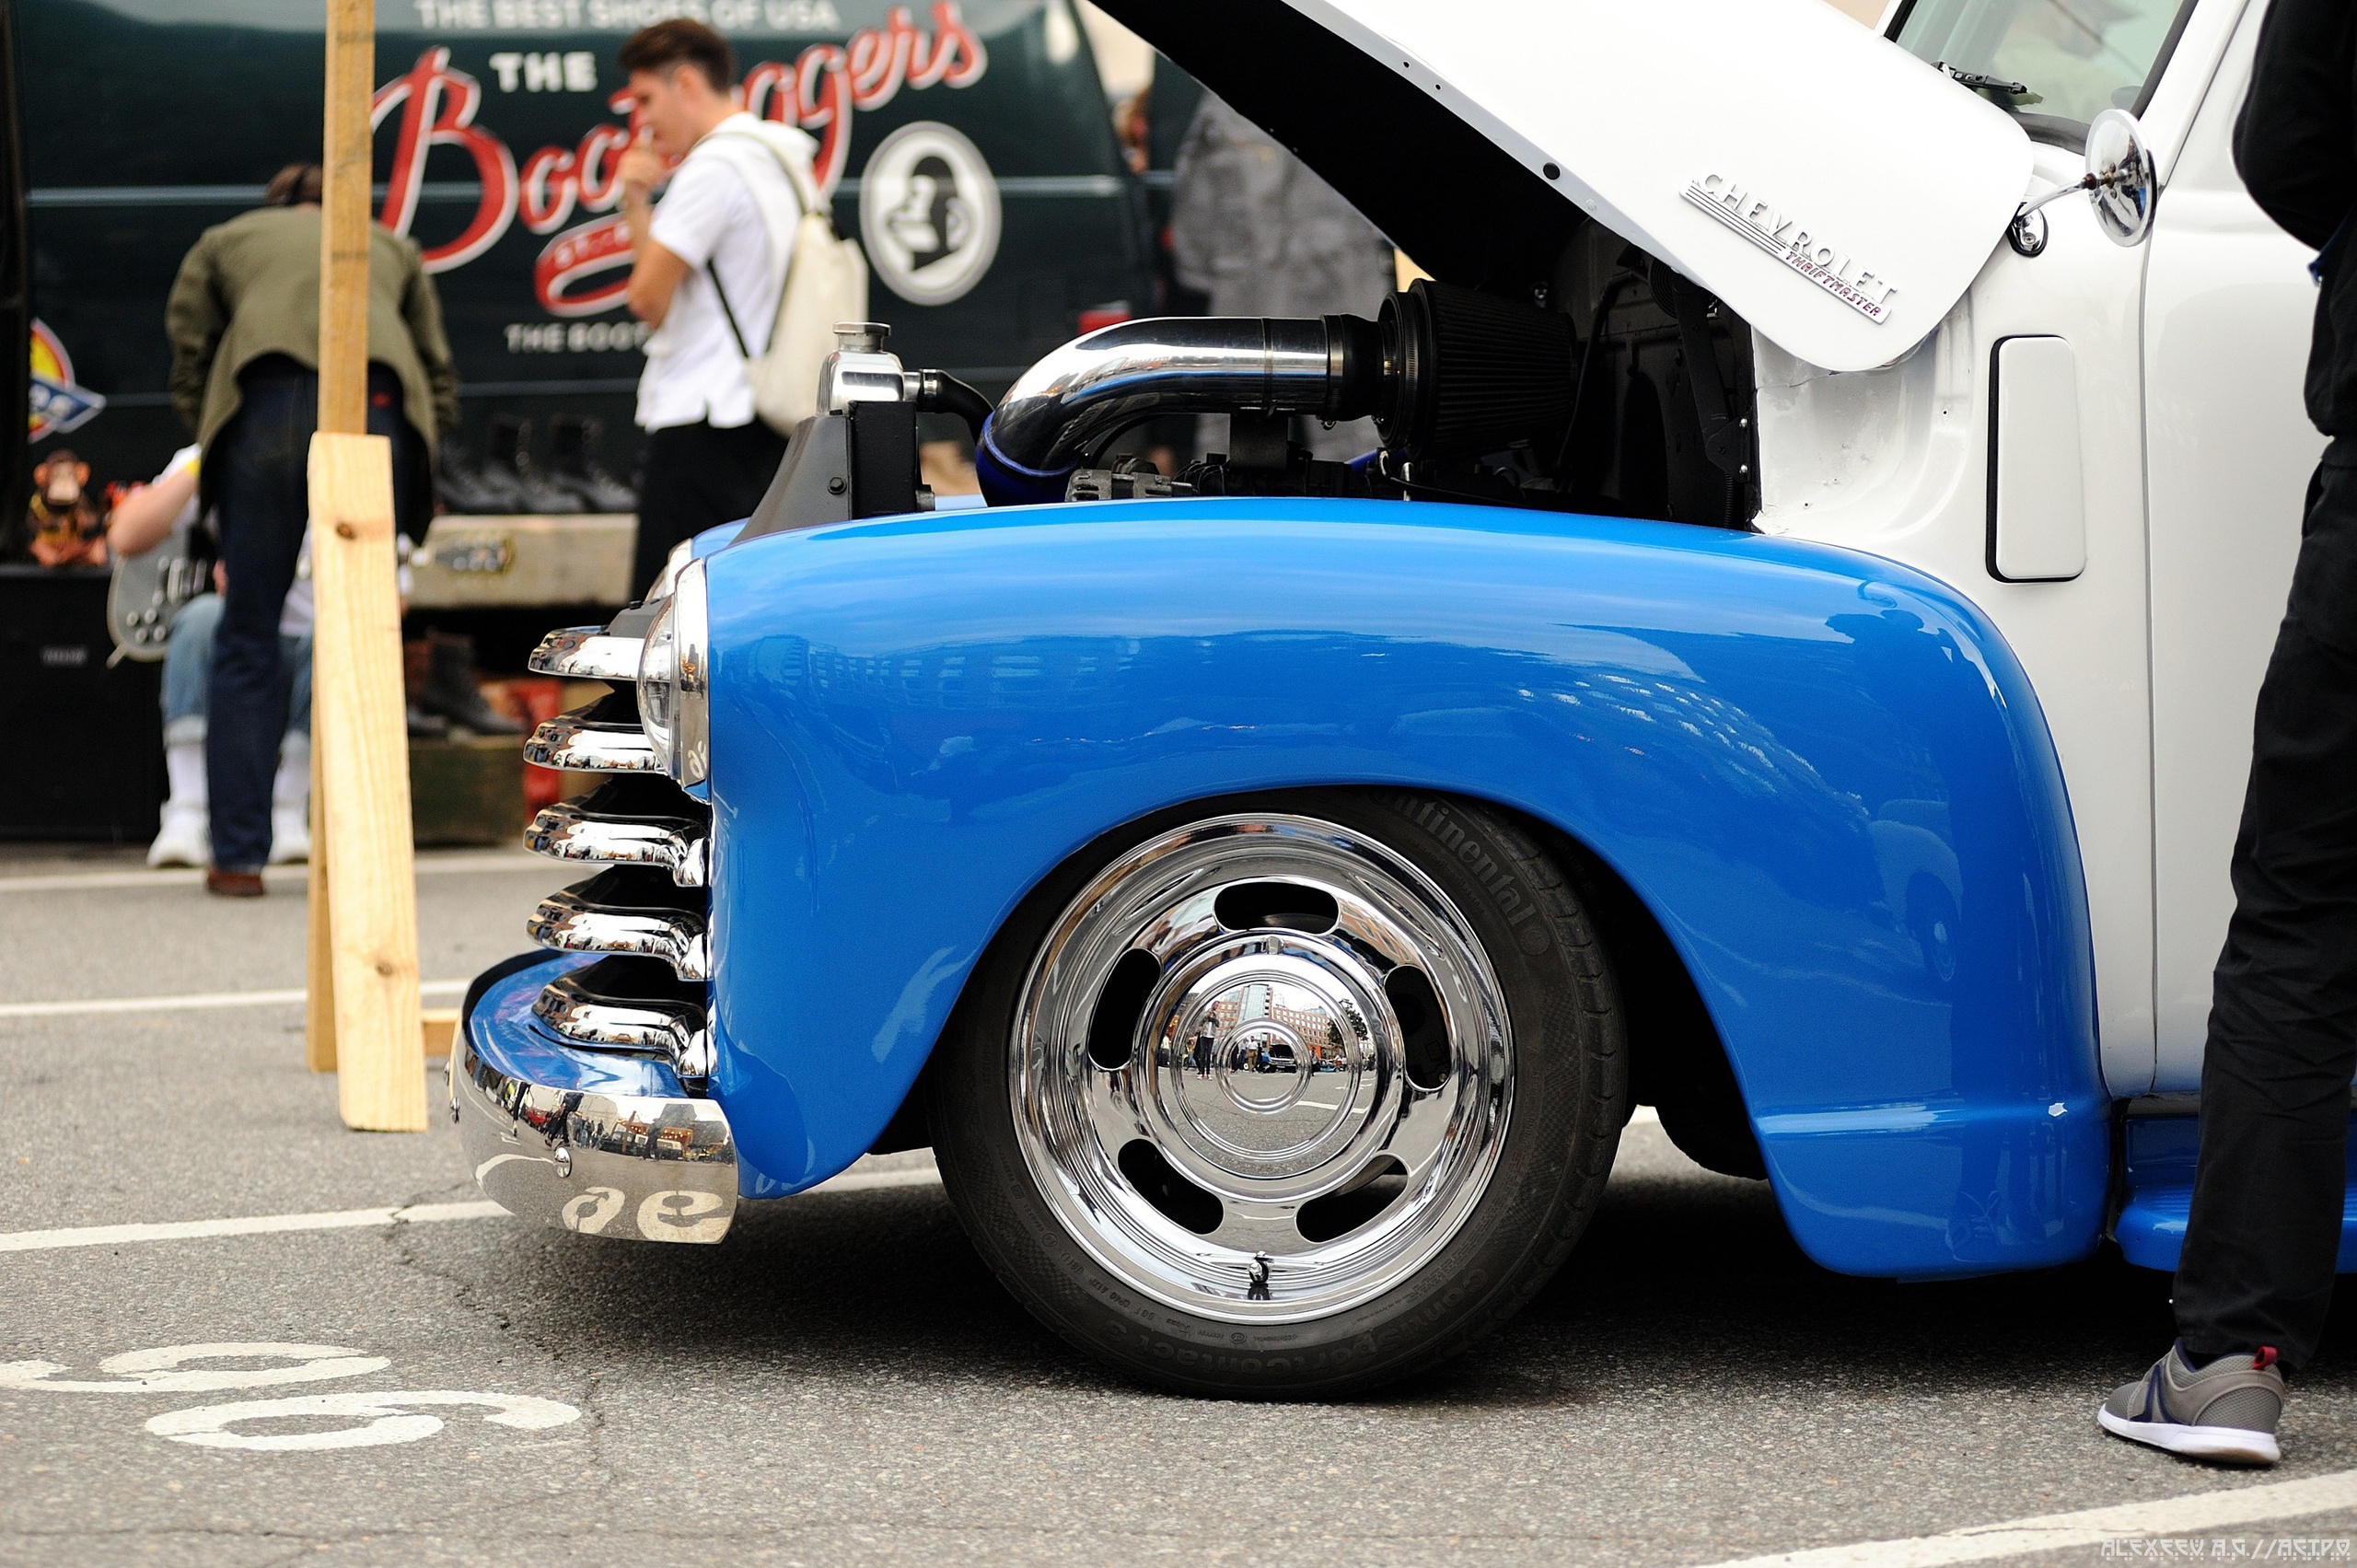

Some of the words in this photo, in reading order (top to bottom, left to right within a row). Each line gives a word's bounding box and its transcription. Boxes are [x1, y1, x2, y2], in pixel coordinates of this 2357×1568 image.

[417, 0, 488, 29] THE
[493, 0, 584, 29] BEST
[712, 0, 758, 29] OF
[765, 0, 842, 30] USA
[488, 51, 597, 92] THE
[1701, 173, 1898, 306] CHEVROLET
[1784, 250, 1883, 318] THRIFTMASTER
[505, 322, 565, 353] THE
